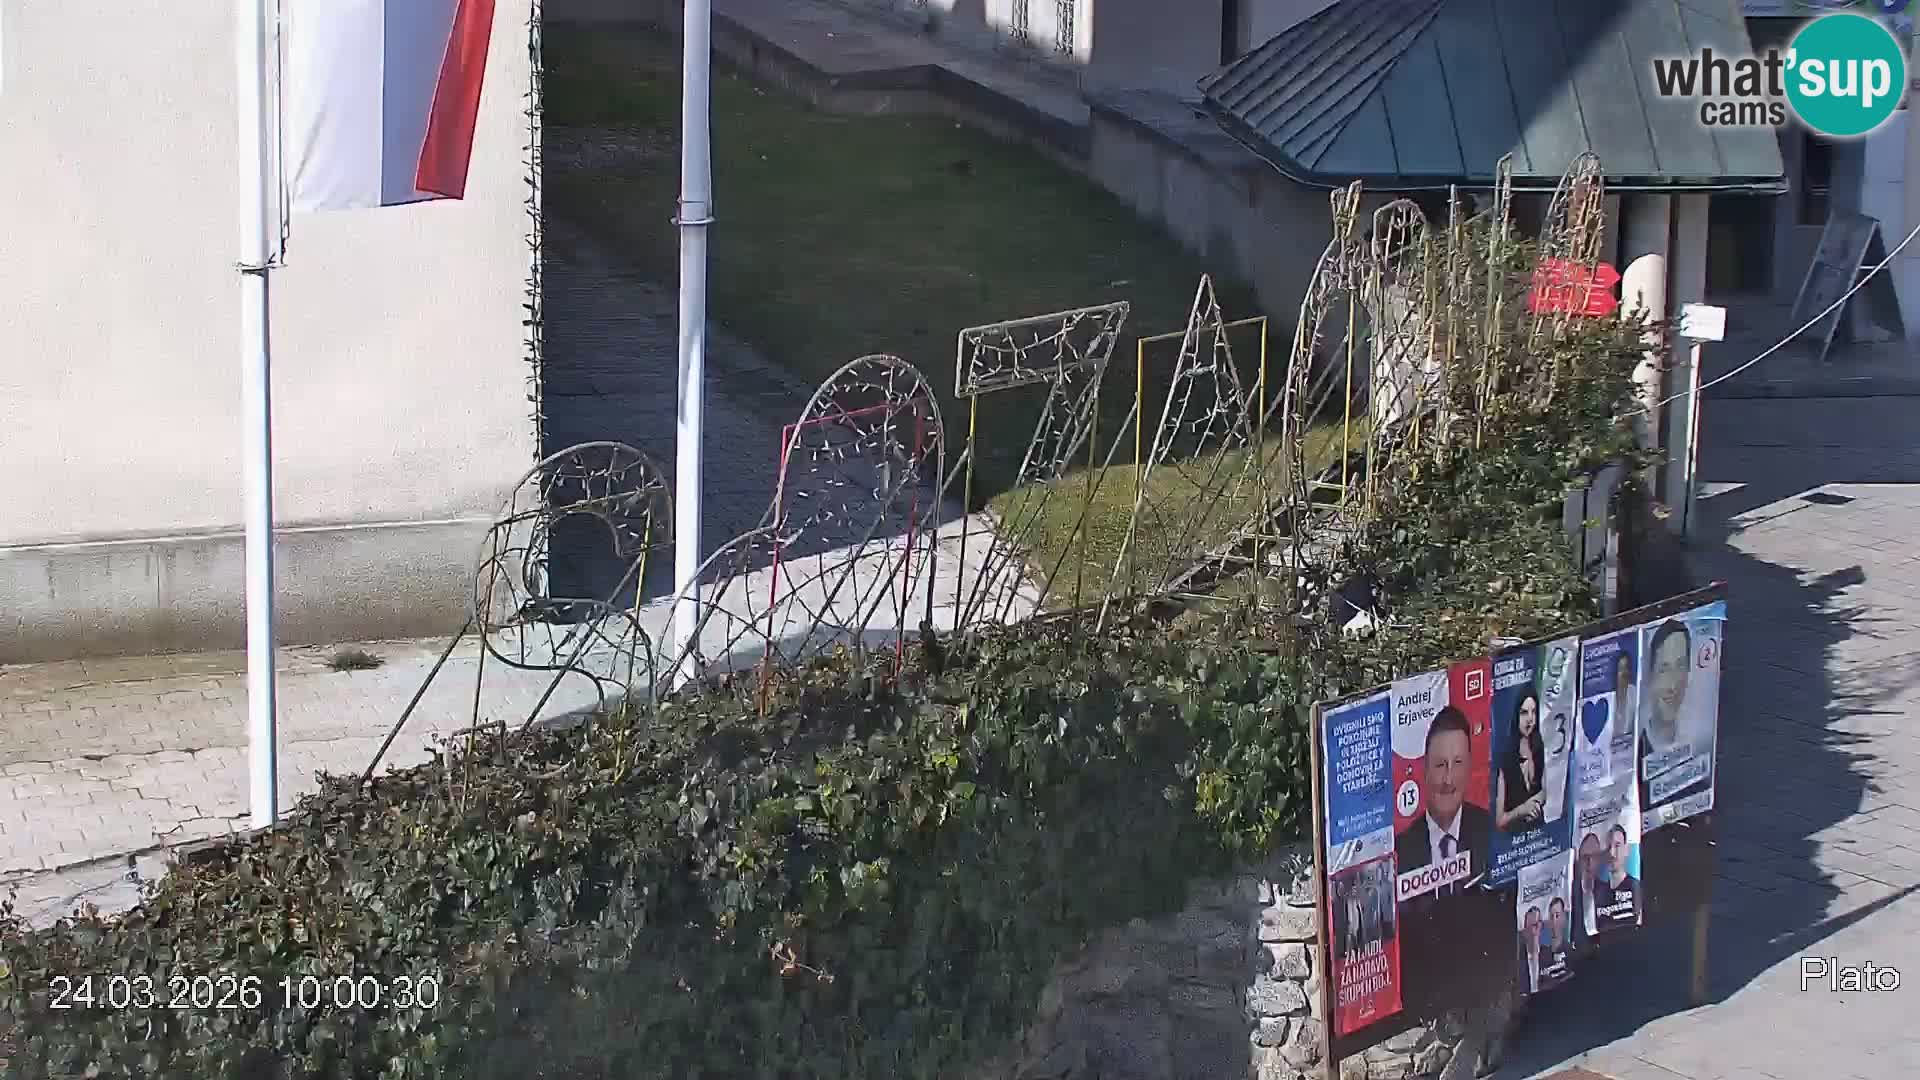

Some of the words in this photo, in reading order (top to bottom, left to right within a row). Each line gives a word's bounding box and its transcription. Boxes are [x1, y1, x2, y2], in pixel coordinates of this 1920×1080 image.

[1398, 688, 1432, 708] Andrej
[1398, 708, 1435, 726] Erjavec
[1552, 712, 1567, 755] 3
[1402, 788, 1416, 809] 13
[1401, 857, 1468, 895] DOGOVOR
